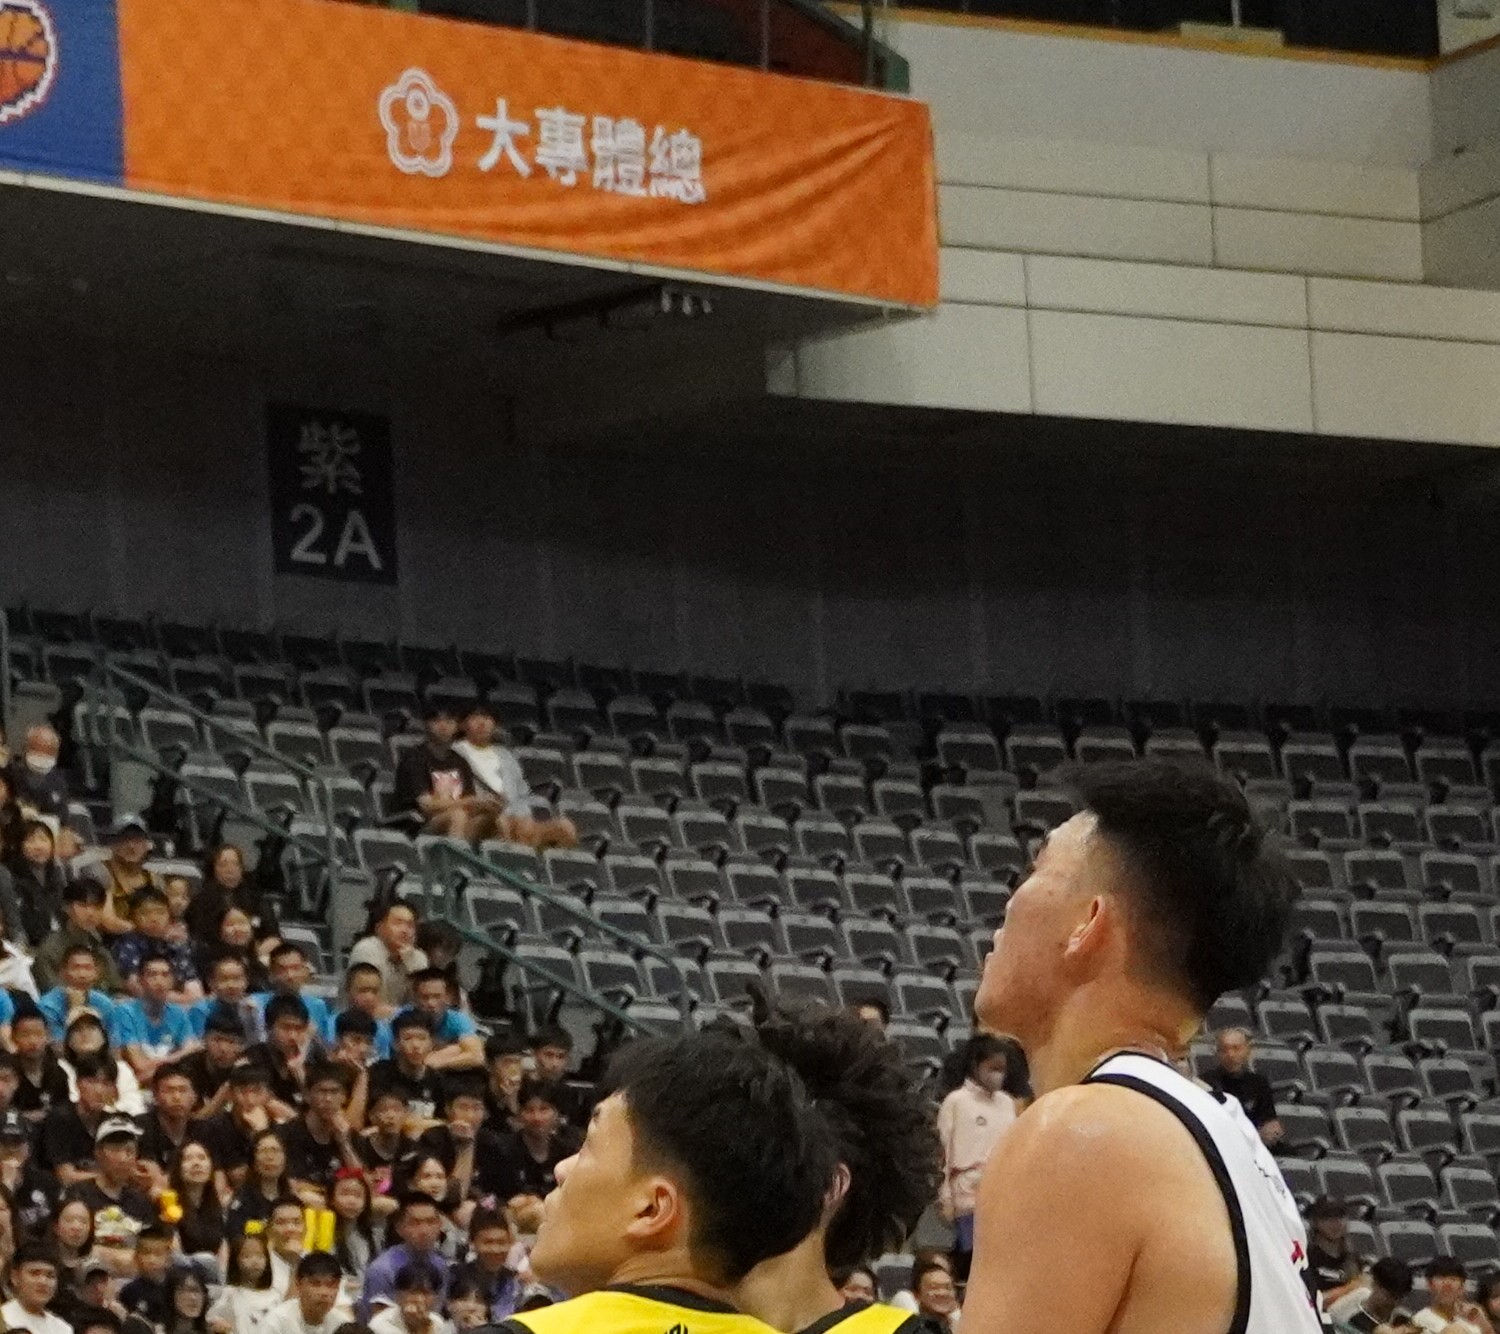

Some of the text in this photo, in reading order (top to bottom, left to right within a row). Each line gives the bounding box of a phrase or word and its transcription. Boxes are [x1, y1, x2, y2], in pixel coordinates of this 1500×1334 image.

[475, 97, 706, 205] 大專體總
[296, 421, 365, 496] 紫
[289, 505, 383, 575] 2A
